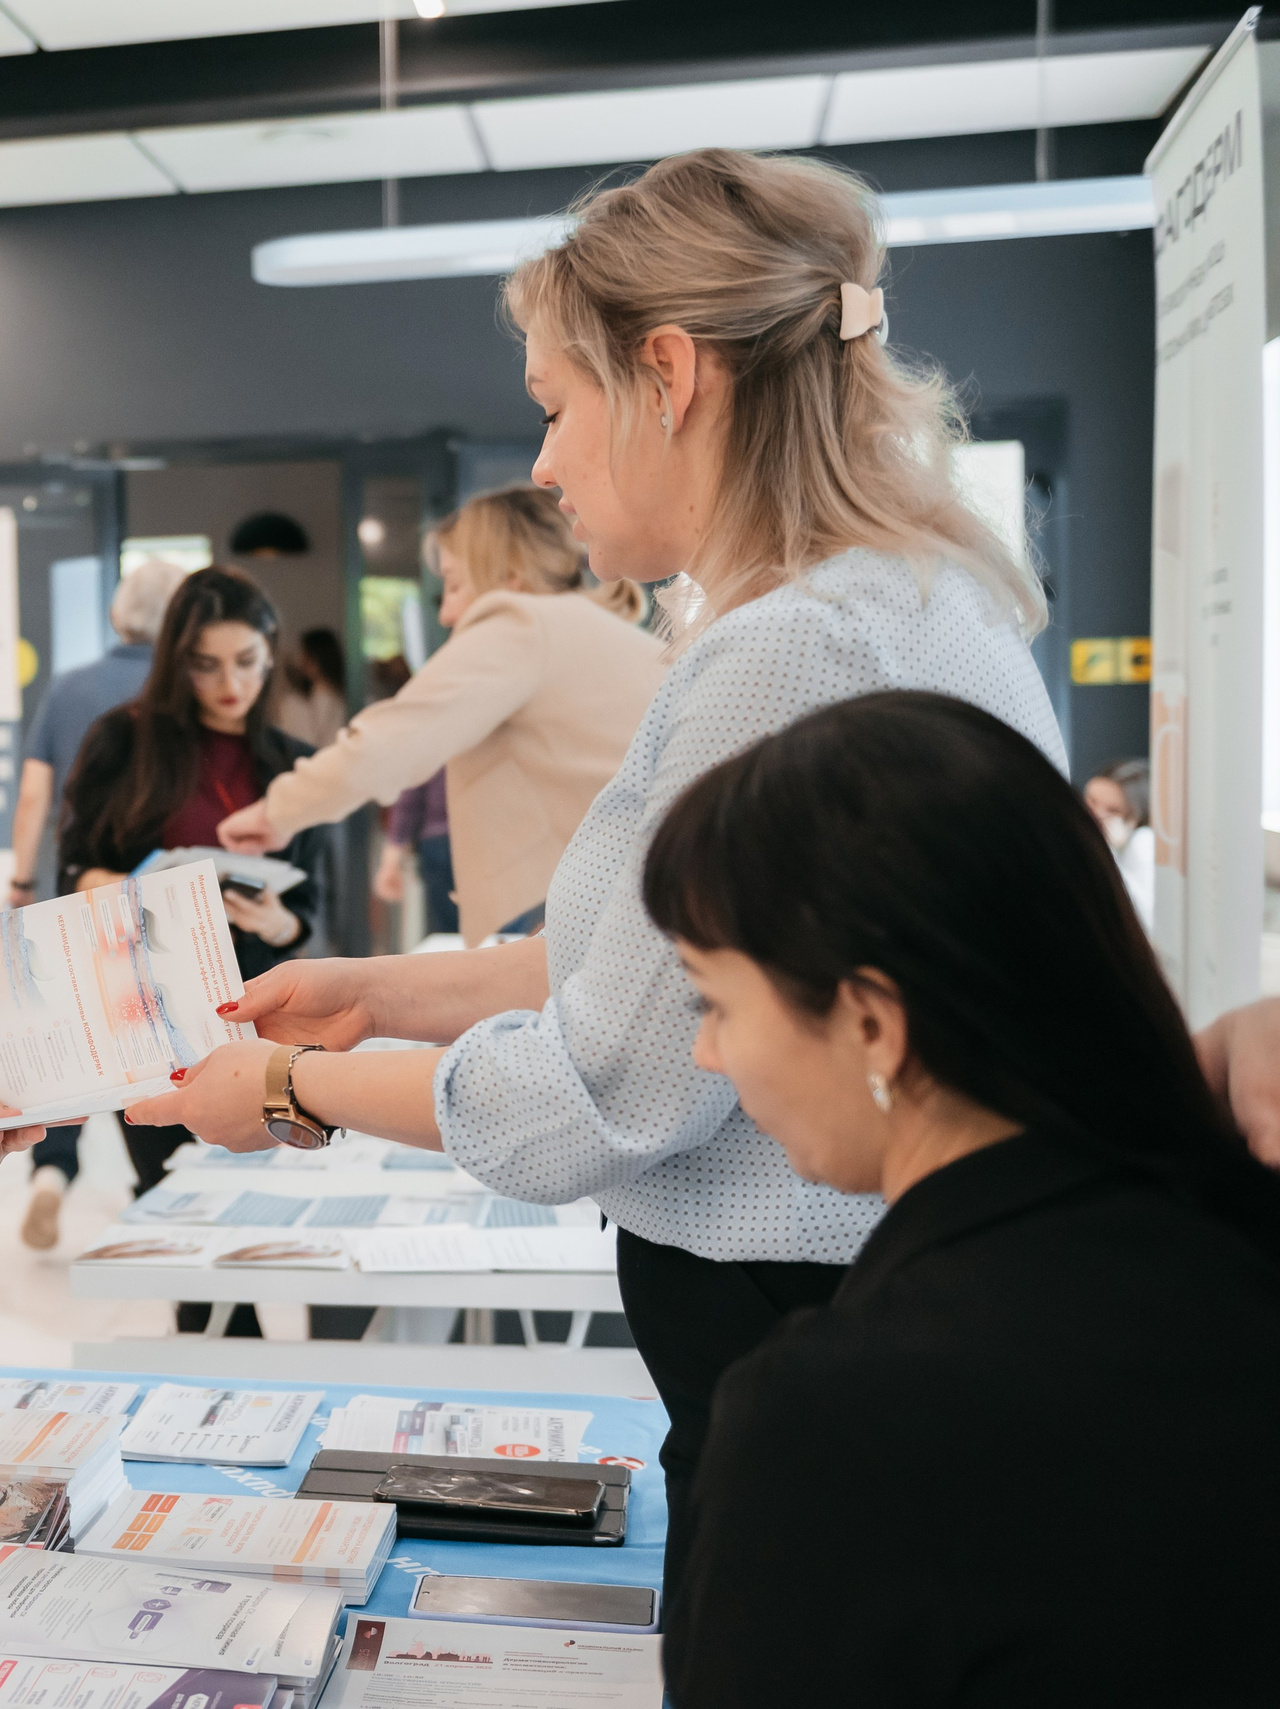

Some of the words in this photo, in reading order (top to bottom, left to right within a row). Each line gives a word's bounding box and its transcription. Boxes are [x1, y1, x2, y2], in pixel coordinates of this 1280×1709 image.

[57, 914, 70, 956] КЕРАМИДЫ
[68, 964, 78, 992] составе
[75, 993, 85, 1021] основы
[83, 1022, 101, 1069] КОМФОДЕРМ
[189, 881, 201, 918] повышает
[198, 921, 215, 978] эффективность
[213, 985, 229, 1027] уменет
[190, 927, 203, 964] побочных
[199, 966, 212, 1002] эффектов
[198, 874, 214, 930] Микронизация
[211, 932, 232, 1002] метилпреднизоло
[215, 1617, 235, 1639] псориаза
